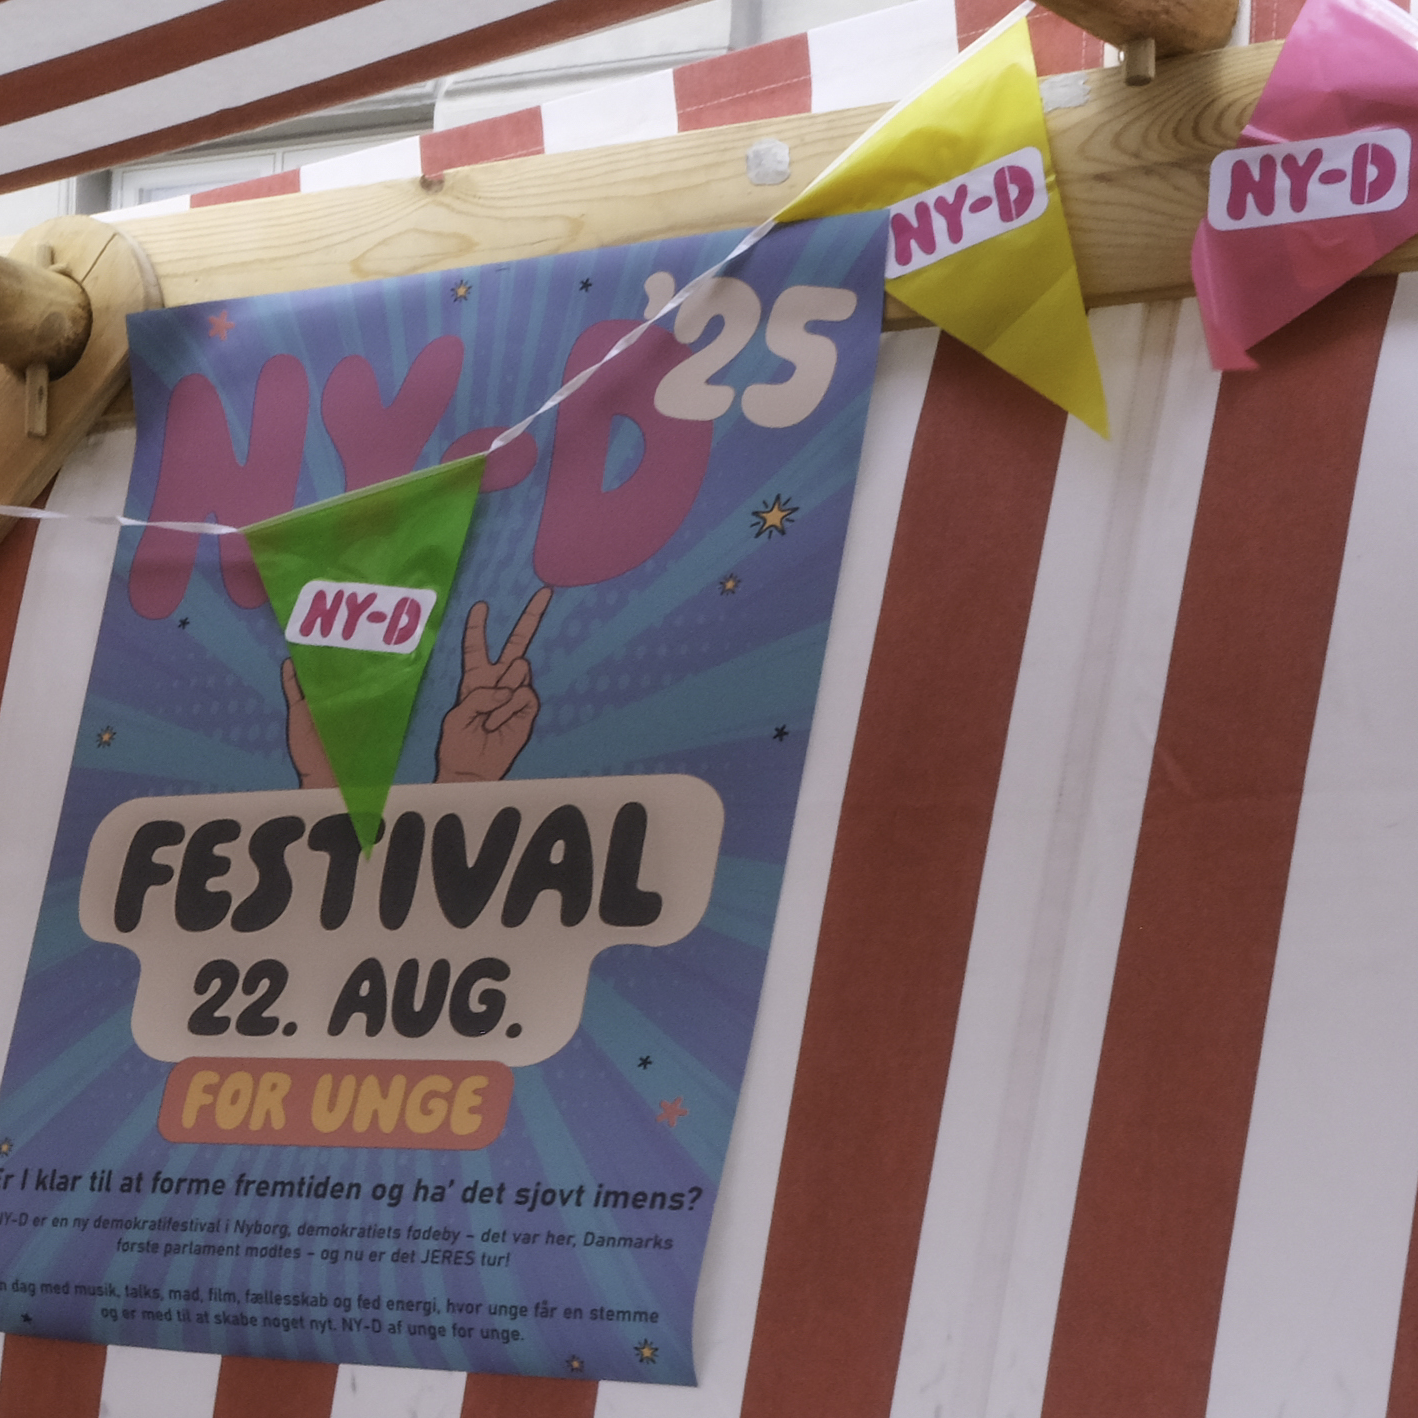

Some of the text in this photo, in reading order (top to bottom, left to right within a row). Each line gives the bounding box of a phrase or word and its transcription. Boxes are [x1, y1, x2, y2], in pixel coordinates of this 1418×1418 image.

[1225, 142, 1398, 221] NY-D
[890, 165, 1035, 267] NY-D
[128, 319, 713, 620] NY-D
[298, 588, 430, 646] NY-D
[113, 802, 663, 934] FESTIVAL
[187, 957, 523, 1040] 22. AUG.
[181, 1071, 490, 1135] FOR UNGE
[21, 1168, 29, 1190] I
[35, 1169, 82, 1193] klar
[90, 1170, 113, 1193] til
[120, 1173, 143, 1194] at
[150, 1171, 226, 1196] forme
[234, 1173, 362, 1201] fremtiden
[371, 1182, 405, 1208] og
[463, 1179, 507, 1206] det
[515, 1181, 586, 1213] sjovt
[593, 1184, 704, 1211] imens?
[32, 1215, 48, 1227] er
[52, 1216, 69, 1228] en
[72, 1216, 90, 1232] ny
[224, 1218, 231, 1234] i
[297, 1222, 401, 1240] demokratiets
[406, 1226, 461, 1244] fødeby
[481, 1228, 507, 1244] det
[512, 1231, 540, 1245] var
[545, 1231, 577, 1249] her,
[583, 1231, 674, 1251] Danmarks
[116, 1237, 160, 1254] første
[163, 1239, 240, 1259] parlament
[245, 1242, 301, 1260] mødtes
[320, 1247, 339, 1264] og
[344, 1250, 363, 1262] nu
[368, 1251, 387, 1263] er
[391, 1249, 416, 1265] det
[420, 1250, 476, 1267] JERES
[11, 1279, 36, 1297] dag
[40, 1280, 70, 1296] med
[244, 1288, 328, 1308] fællesskab
[333, 1293, 351, 1311] og
[357, 1294, 381, 1311] fed
[386, 1297, 441, 1316] energi,
[446, 1297, 483, 1316] hvor
[489, 1303, 528, 1321] unge
[534, 1300, 557, 1320] får
[563, 1306, 583, 1320] en
[590, 1306, 660, 1324] stemme
[101, 1308, 525, 1344] og er med til at skabe noget nyt. NY-D af unge for unge.
